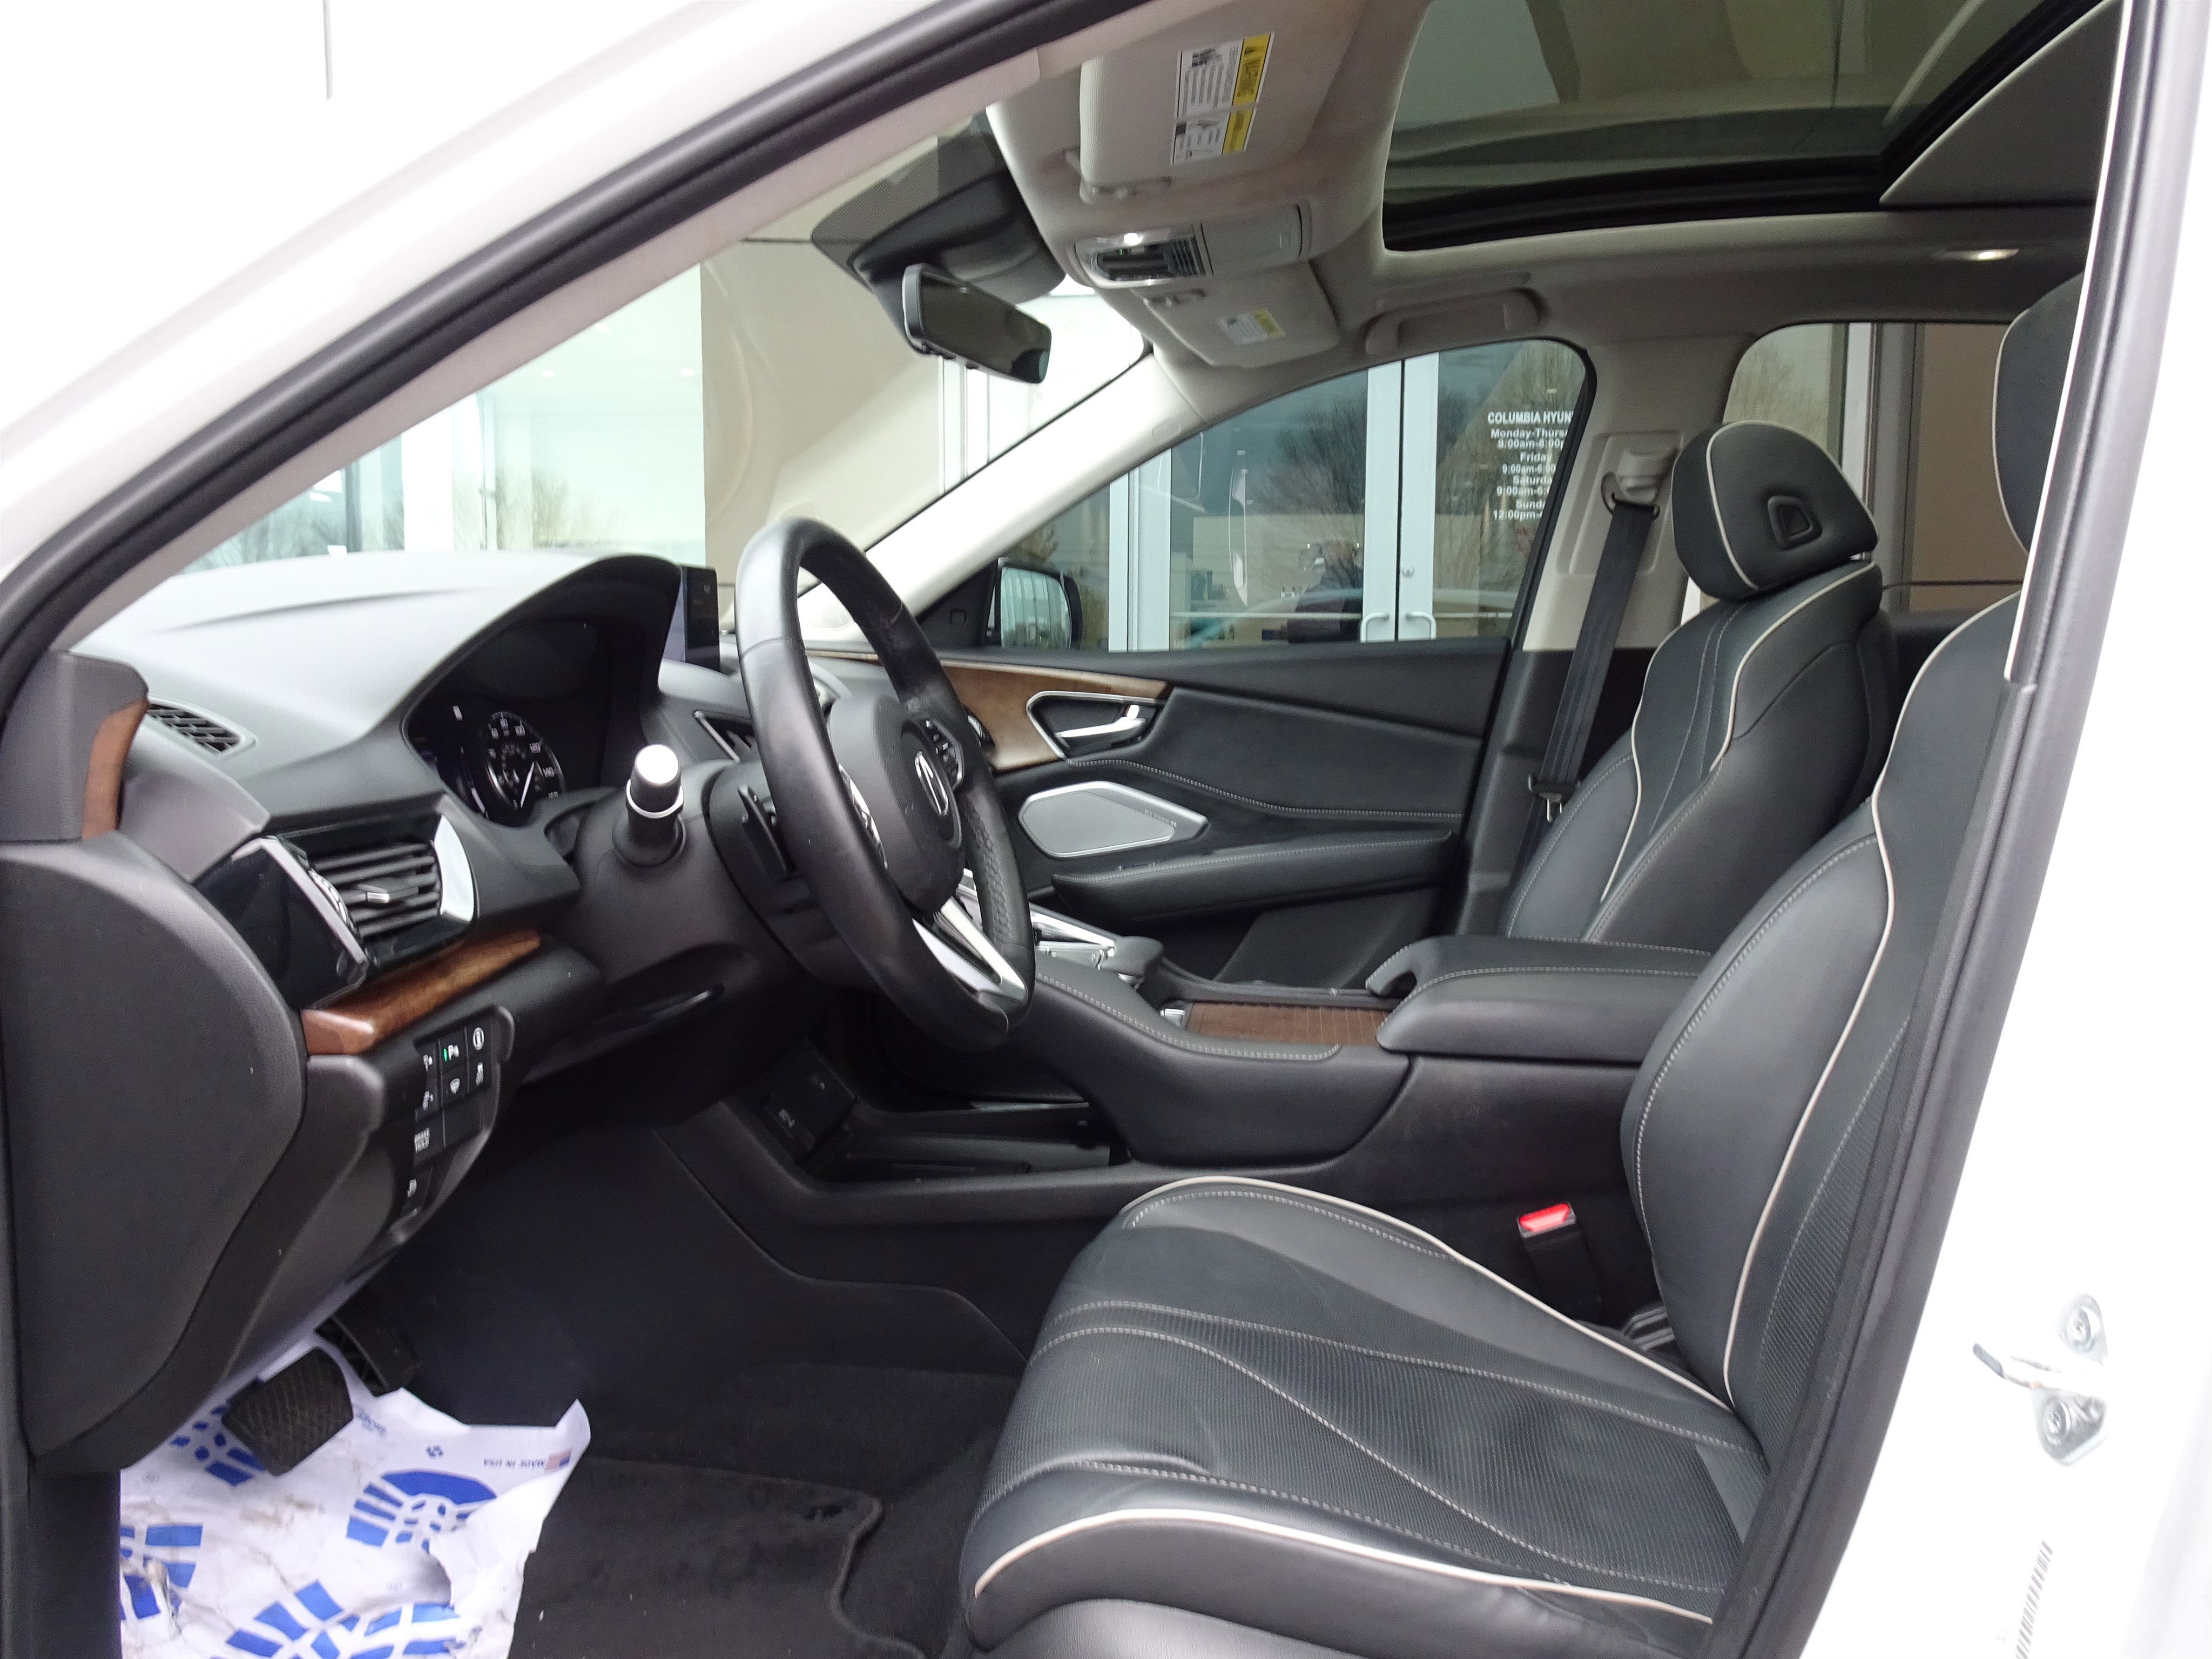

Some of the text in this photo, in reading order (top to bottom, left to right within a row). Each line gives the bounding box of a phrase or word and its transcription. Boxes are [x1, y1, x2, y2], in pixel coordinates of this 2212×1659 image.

[1487, 410, 1574, 425] COLUMBIA HYUN
[1520, 451, 1552, 462] Friday
